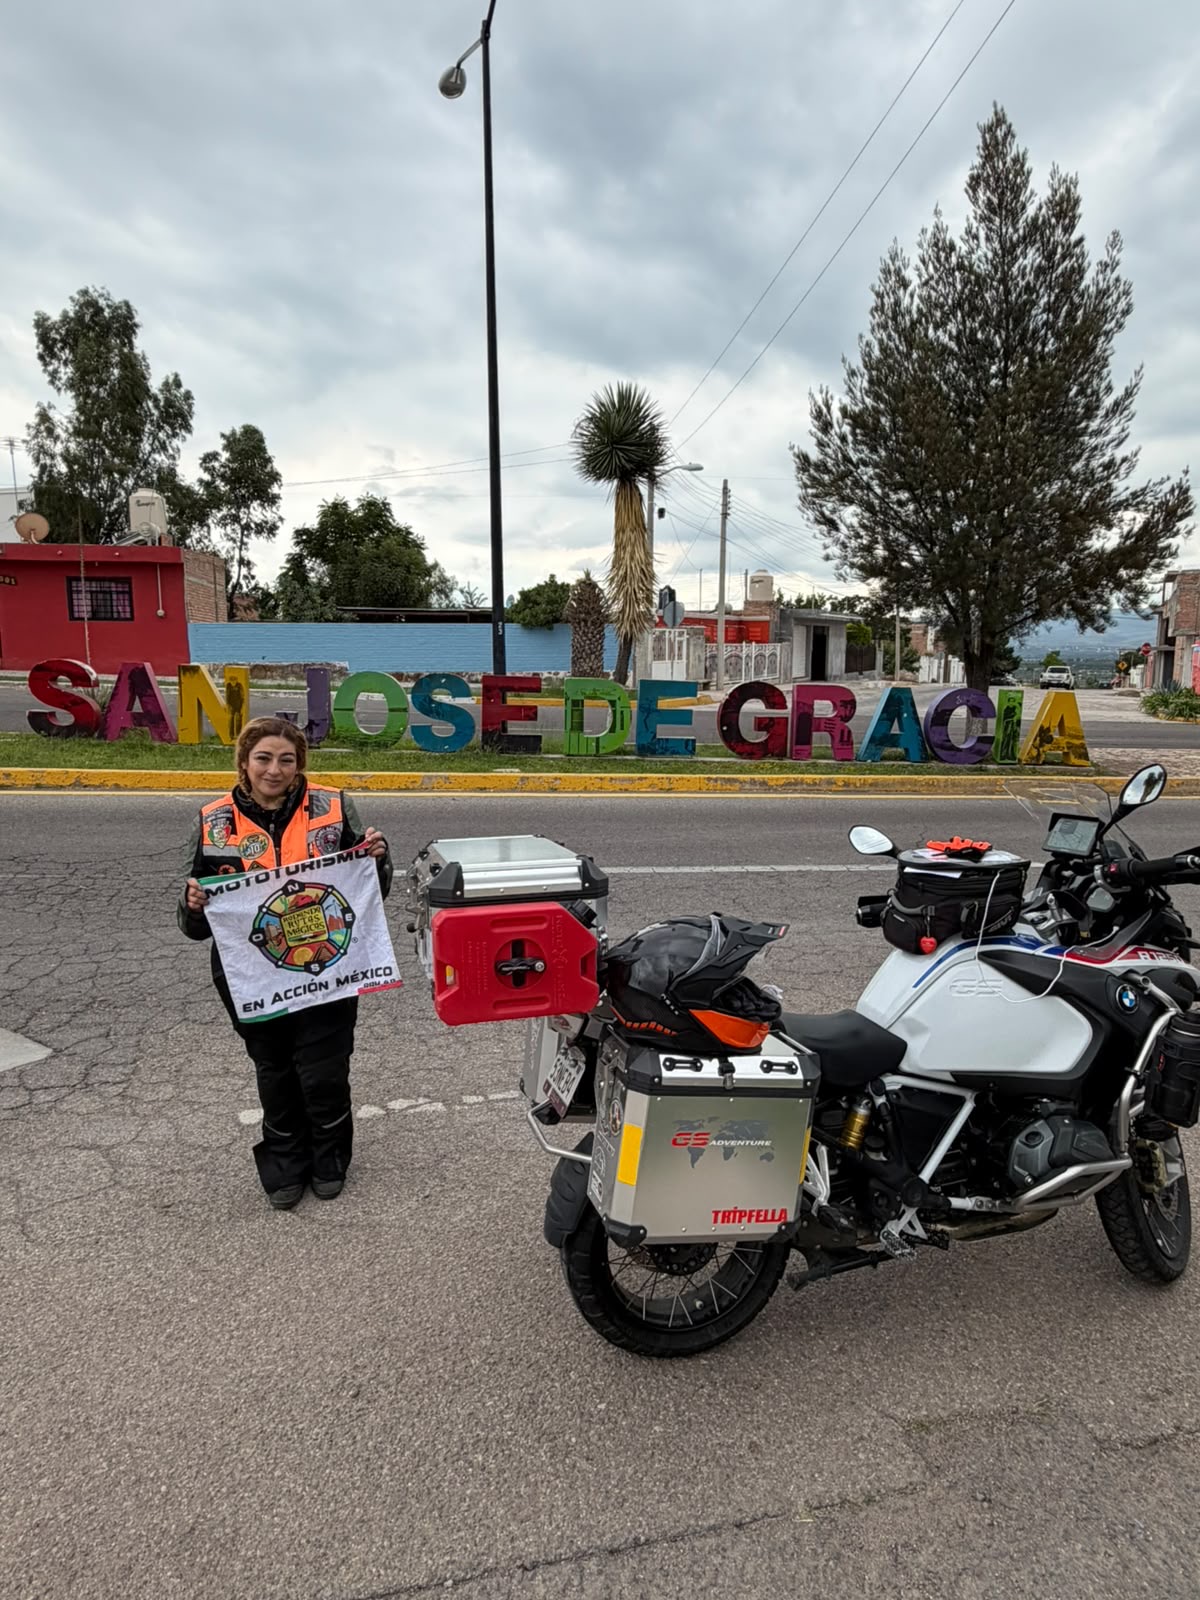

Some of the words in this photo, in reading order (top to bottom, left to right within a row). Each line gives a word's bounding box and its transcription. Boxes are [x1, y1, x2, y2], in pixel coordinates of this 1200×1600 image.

[27, 658, 249, 745] SAN
[274, 664, 543, 755] JOSE
[564, 676, 698, 758] DE
[717, 681, 1092, 767] GRACIA
[204, 848, 370, 899] MOTOTURISMO
[242, 999, 264, 1013] EN
[271, 978, 329, 1006] ACCIÓN
[335, 966, 393, 988] MÉXICO
[671, 1131, 711, 1148] GS
[709, 1139, 773, 1147] ADVENTURE
